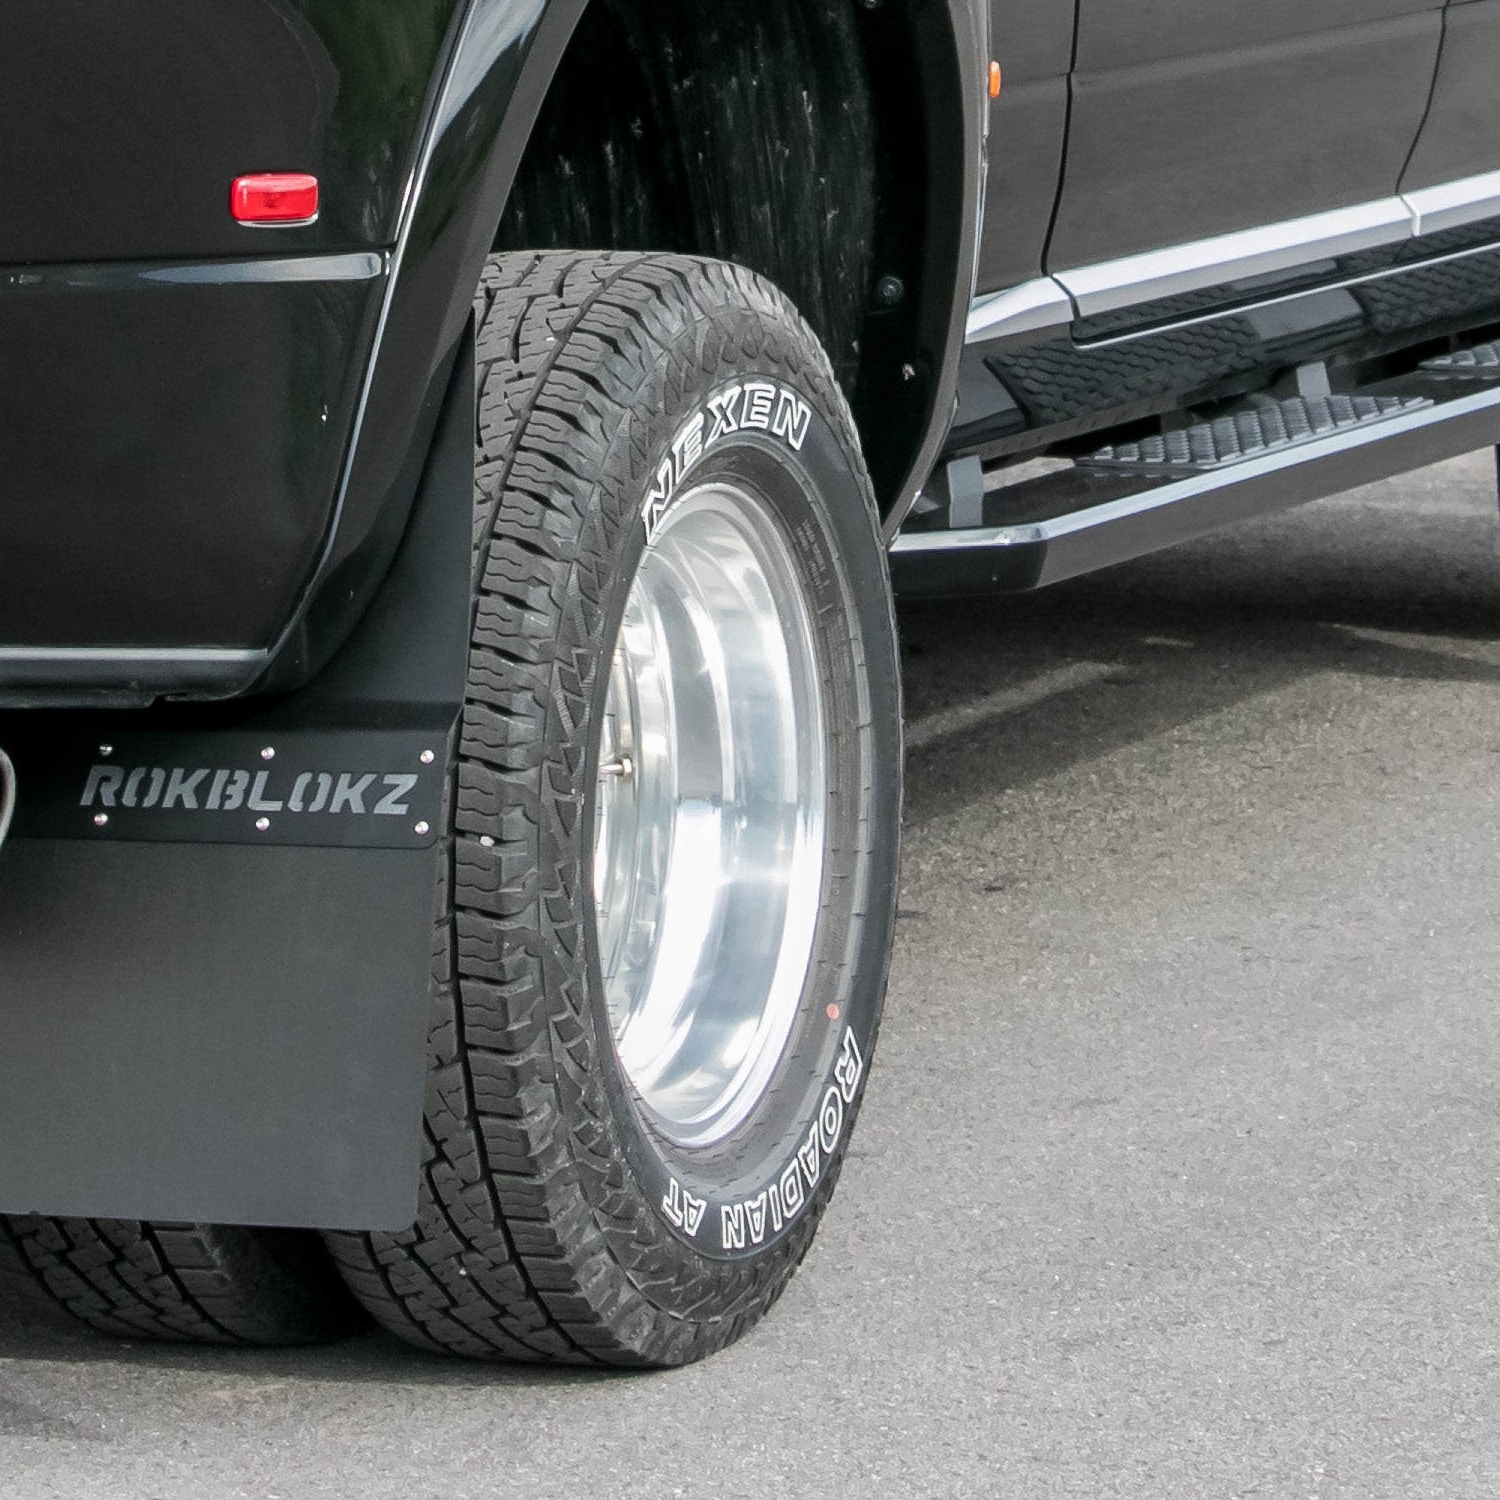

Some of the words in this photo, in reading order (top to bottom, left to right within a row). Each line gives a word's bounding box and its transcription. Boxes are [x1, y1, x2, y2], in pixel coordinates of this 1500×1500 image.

[642, 382, 812, 546] NEXEN
[79, 764, 420, 815] ROKBLOKZ
[720, 1026, 864, 1249] ROADIAN
[660, 1176, 707, 1237] AT
